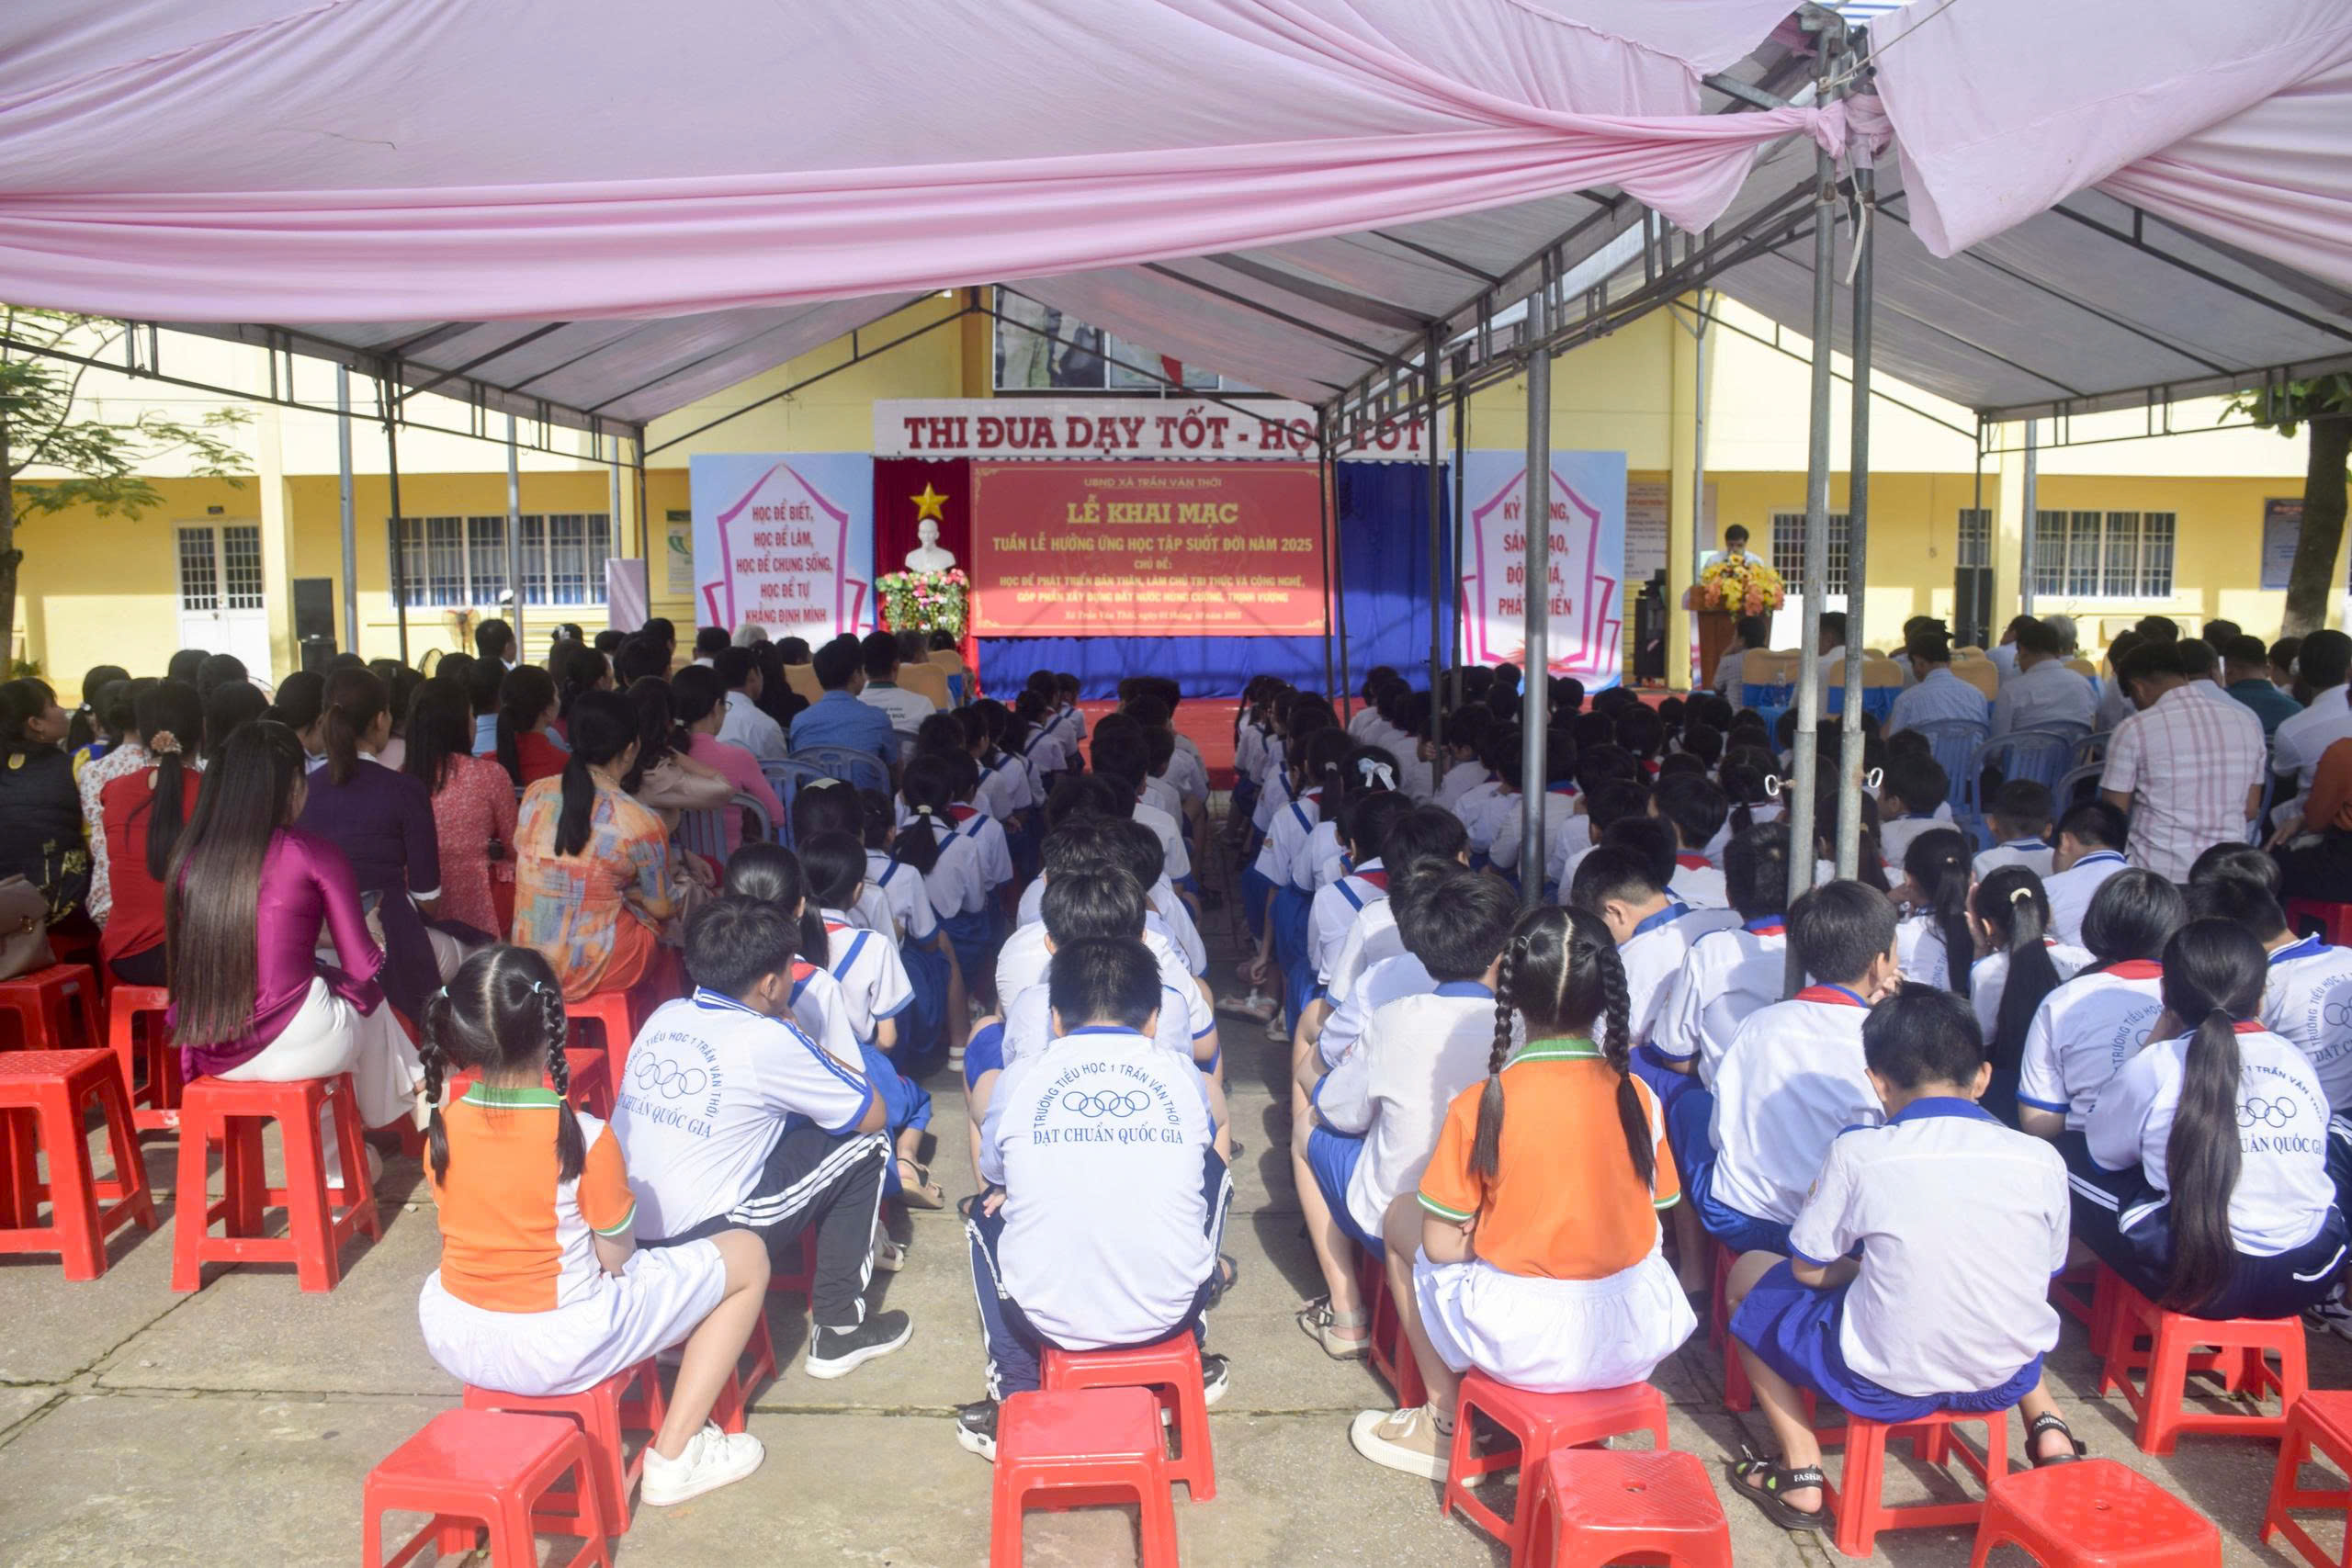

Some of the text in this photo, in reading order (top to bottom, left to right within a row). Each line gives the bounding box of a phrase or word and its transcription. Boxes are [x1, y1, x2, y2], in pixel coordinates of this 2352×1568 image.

[904, 417, 968, 449] THI
[977, 416, 1057, 449] ĐUA
[1066, 416, 1146, 454] DẠY
[1156, 405, 1229, 449] TỐT
[1084, 477, 1115, 487] UBND
[752, 498, 814, 525] HỌC ĐỂ BIẾT,
[1068, 493, 1238, 529] LỄ KHAI MẠC
[753, 525, 813, 549] HỌC ĐỂ LÀM,
[993, 532, 1027, 551] TUẦN
[1031, 531, 1046, 551] LỄ
[1098, 534, 1124, 551] ỨNG
[1127, 537, 1154, 553] HỌC
[1158, 534, 1182, 554] TẬP
[1186, 532, 1219, 551] SUỐT
[1223, 536, 1245, 551] ĐỜI
[1249, 534, 1277, 551] NĂM
[1282, 537, 1312, 551] 2025
[1503, 529, 1568, 555] SÁN ẠO,
[736, 551, 832, 576] HỌC ĐỂ CHUNG SỐNG,
[1134, 556, 1153, 570] CHỦ
[1507, 561, 1525, 587] ĐỘ
[761, 576, 811, 602] HỌC ĐỂ TỰ
[1547, 588, 1572, 615] IỂN
[778, 609, 800, 626] ĐỊNH
[803, 605, 827, 623] MÌNH
[1034, 1088, 1059, 1129] TRƯỜNG
[1055, 1066, 1080, 1089] TIỂU
[1081, 1062, 1106, 1077] HỌC
[1120, 1064, 1149, 1084] TRẦN
[1148, 1078, 1169, 1100] VĂN
[1163, 1100, 1182, 1126] THỜI
[652, 1105, 687, 1129] QUỐC
[687, 1118, 712, 1139] GIA
[1034, 1121, 1183, 1146] ĐẠT CHUẨN QUỐC GIA
[2240, 1133, 2270, 1154] UẨN
[2273, 1133, 2310, 1156] QUỐC
